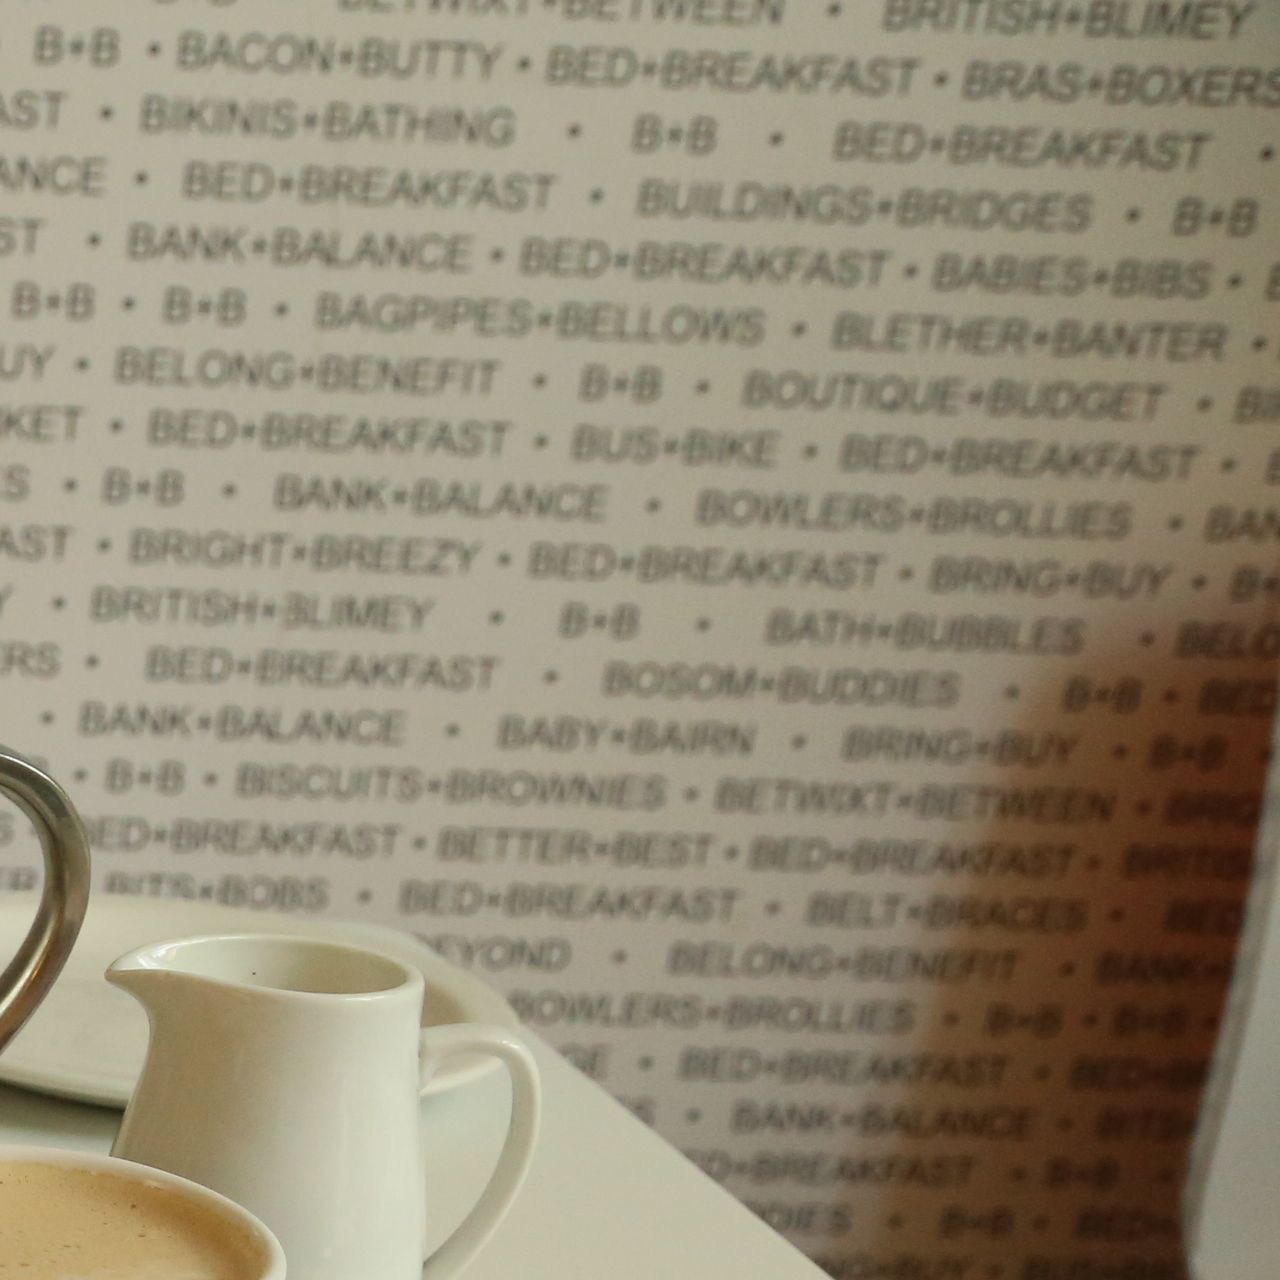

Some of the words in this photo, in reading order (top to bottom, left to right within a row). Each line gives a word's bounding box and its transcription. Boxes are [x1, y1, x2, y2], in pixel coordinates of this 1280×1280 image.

[34, 25, 119, 67] B+B
[177, 31, 501, 79] BACON+BUTTY
[546, 47, 920, 97] BED+BREAKFAST
[632, 114, 717, 156] B+B
[833, 123, 1212, 172] BED+BREAKFAST
[11, 281, 95, 321] B+B
[163, 286, 246, 326] B+B
